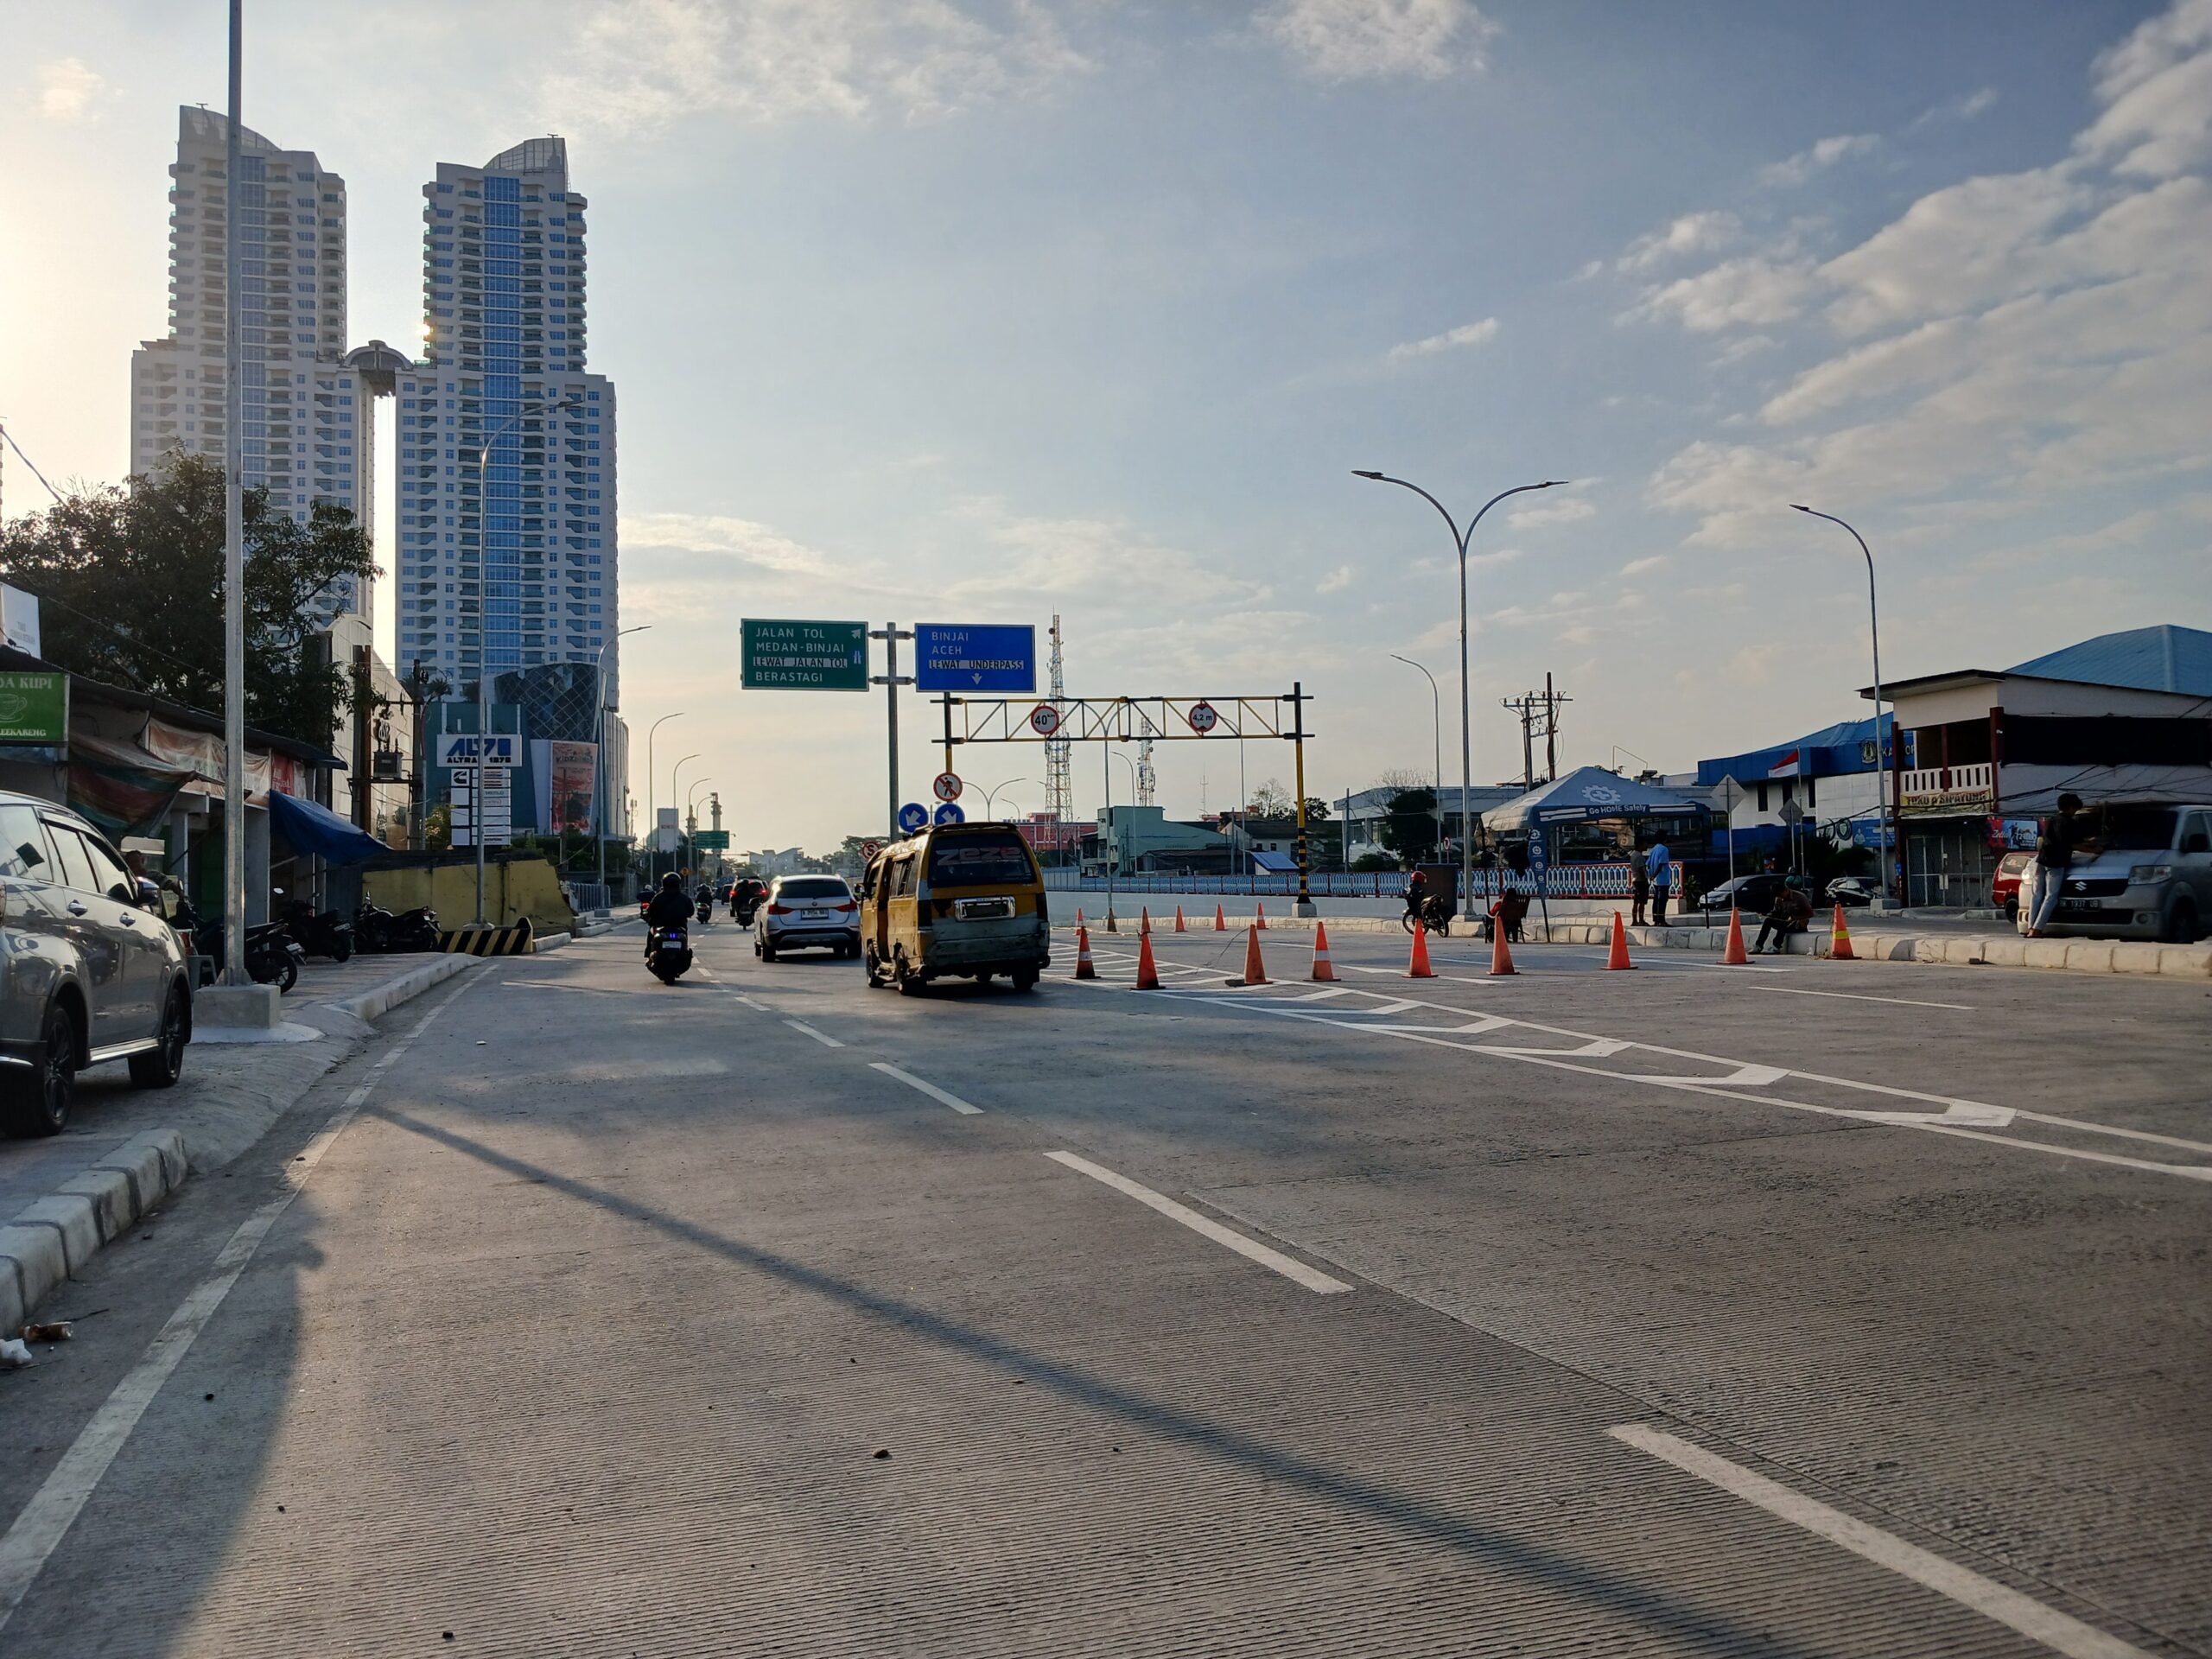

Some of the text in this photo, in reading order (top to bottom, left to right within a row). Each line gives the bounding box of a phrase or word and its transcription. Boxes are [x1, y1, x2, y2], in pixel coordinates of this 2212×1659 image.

[756, 627, 825, 639] JALAN TOL
[931, 632, 969, 641] BINJAI
[756, 642, 844, 653] MEDAN-BINJAI
[931, 645, 962, 655] ACEH
[754, 657, 847, 669] LEWAT JALAN TOL
[931, 660, 1022, 670] LEWAT UNDERPASS
[755, 671, 823, 682] BERASTAGI
[20, 677, 52, 690] KUPI
[1034, 715, 1047, 726] 40
[1600, 804, 1623, 814] HOME
[1624, 804, 1647, 812] Safely
